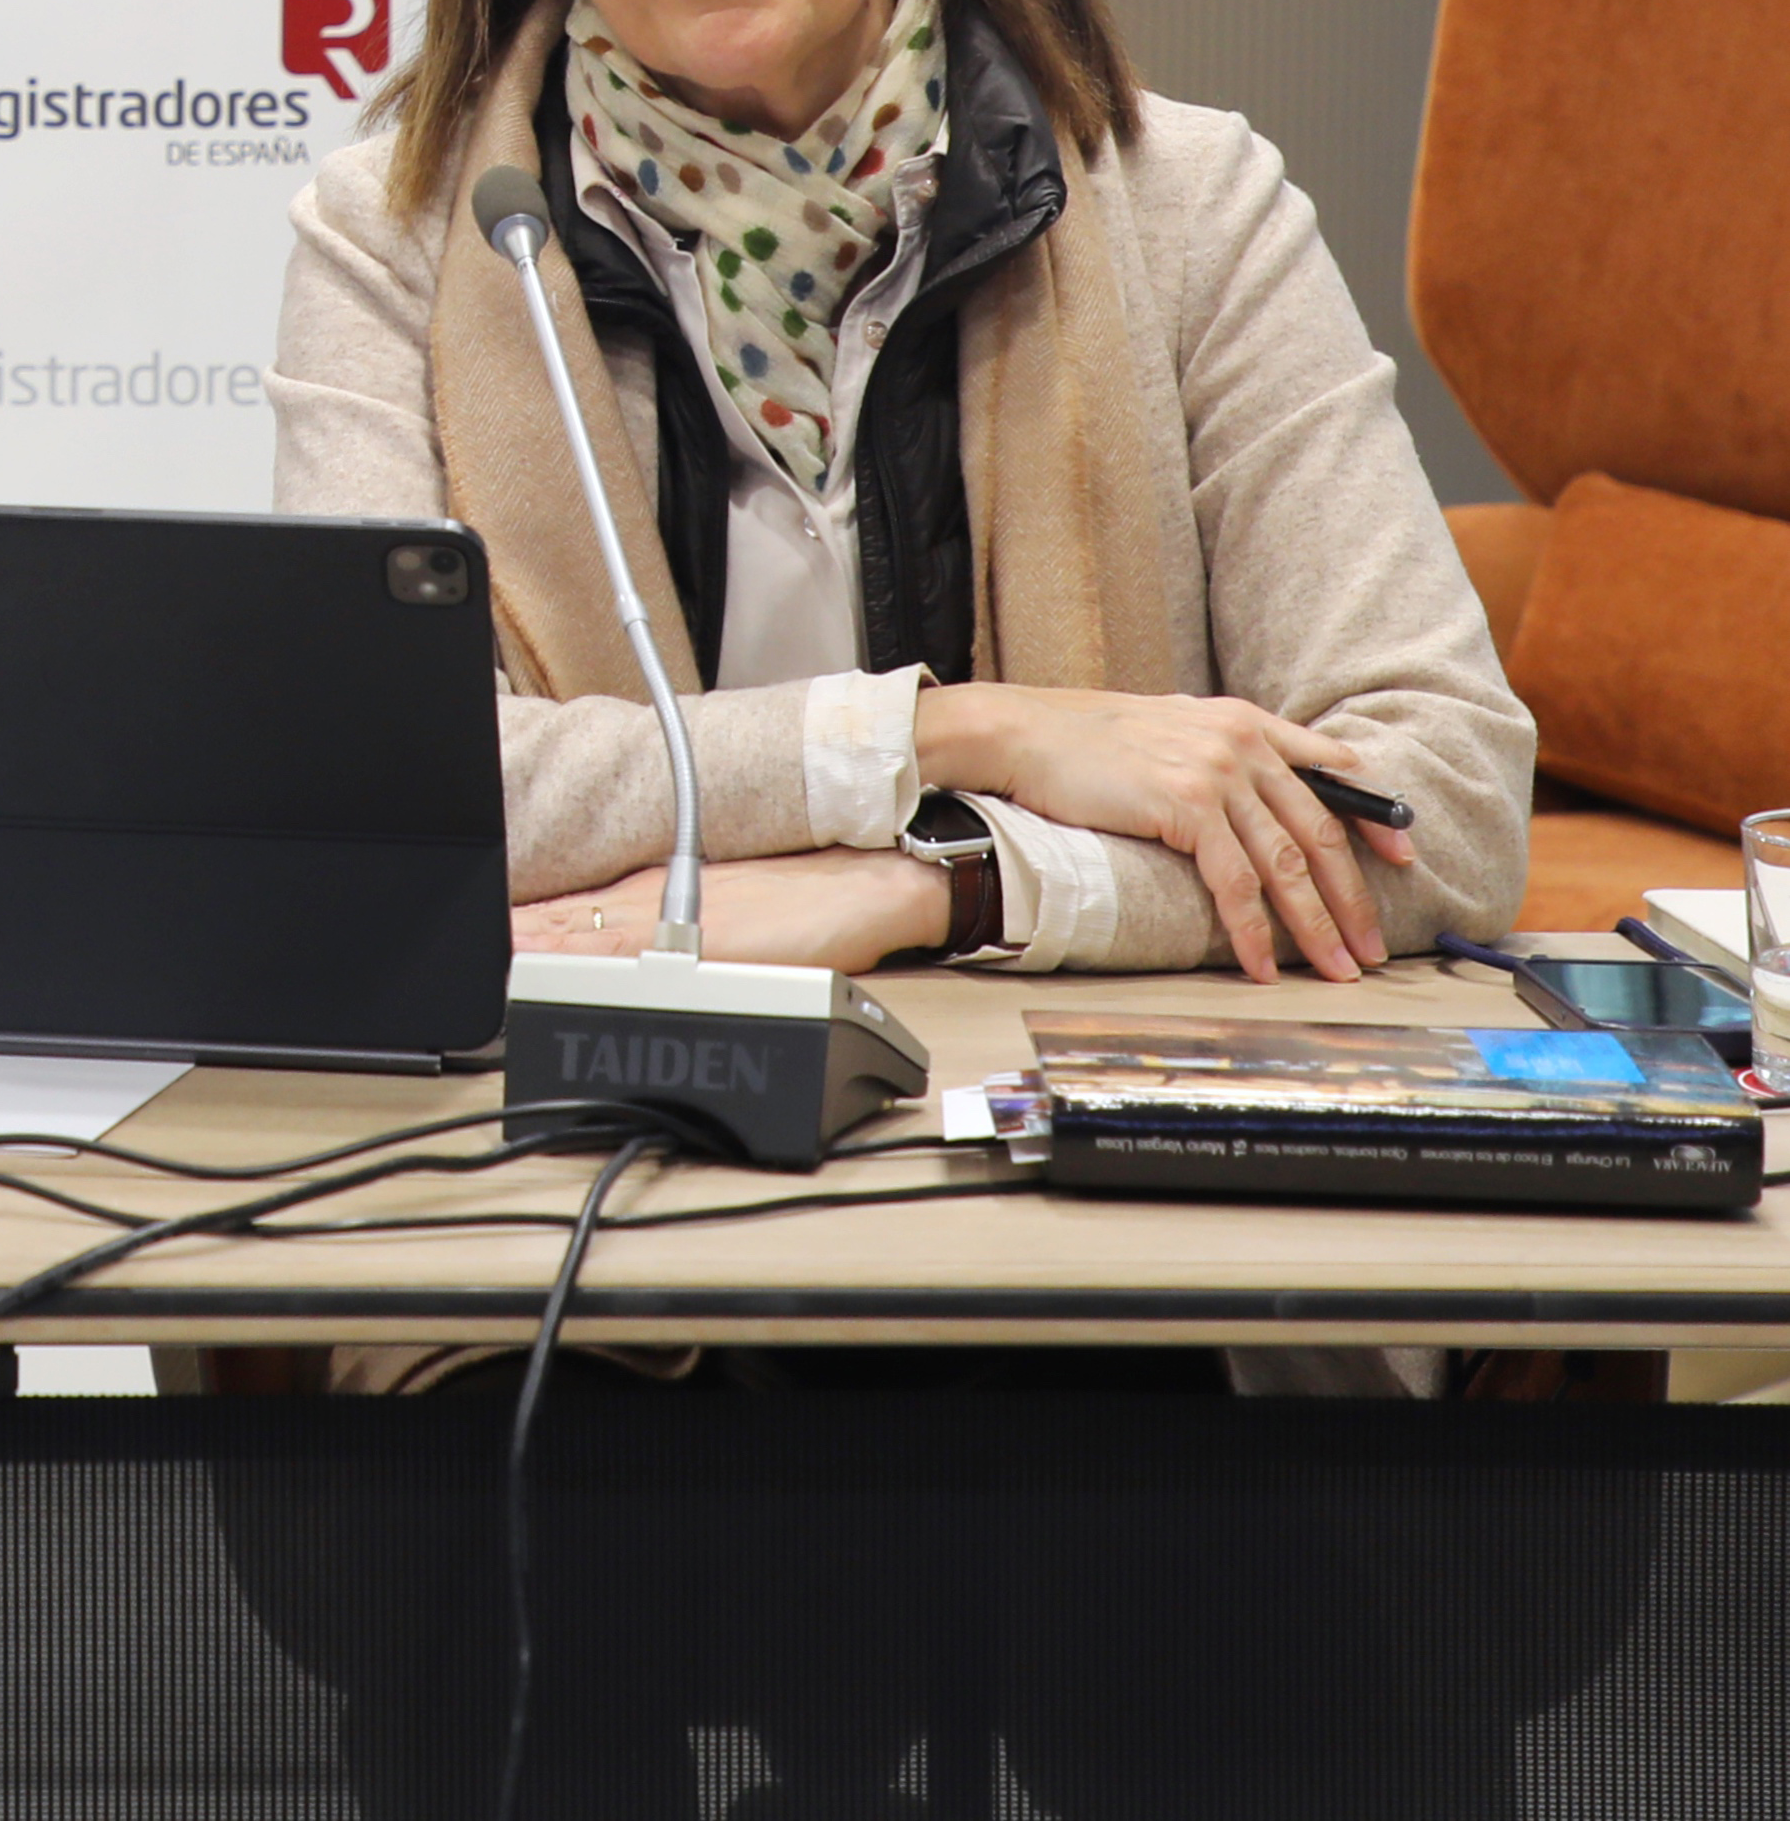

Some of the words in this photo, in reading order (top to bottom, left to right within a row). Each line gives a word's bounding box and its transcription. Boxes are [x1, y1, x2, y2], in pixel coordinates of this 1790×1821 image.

[166, 140, 198, 166] DE
[206, 136, 310, 166] ESPAÑA
[554, 1030, 770, 1095] TAIDEN
[1136, 1136, 1183, 1155] Vargas
